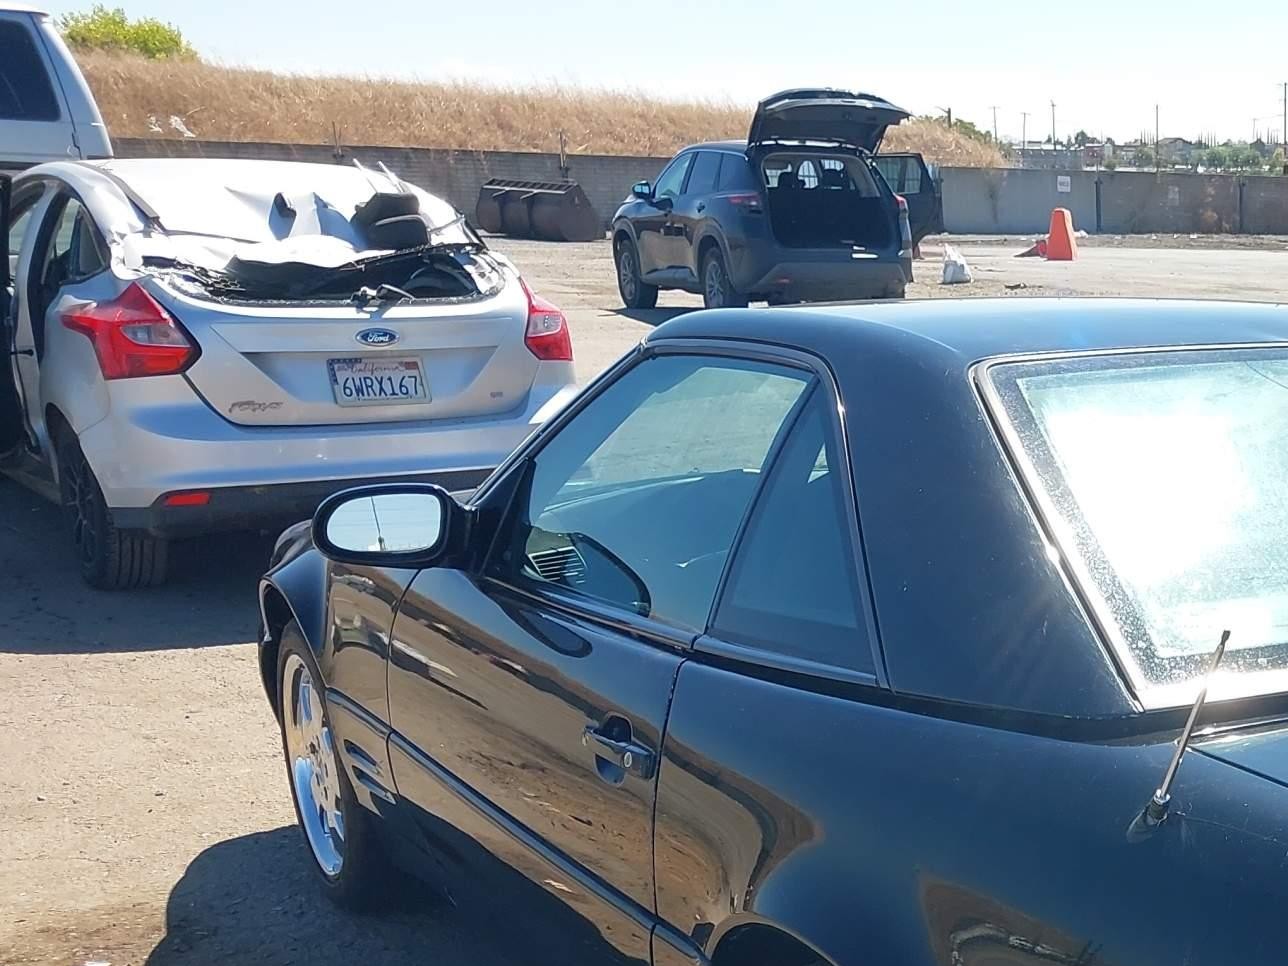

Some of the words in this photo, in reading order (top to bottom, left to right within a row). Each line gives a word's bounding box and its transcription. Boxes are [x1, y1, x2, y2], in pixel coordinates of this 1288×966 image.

[367, 331, 390, 342] Ford
[350, 361, 406, 375] California
[342, 375, 418, 397] 6WRX167
